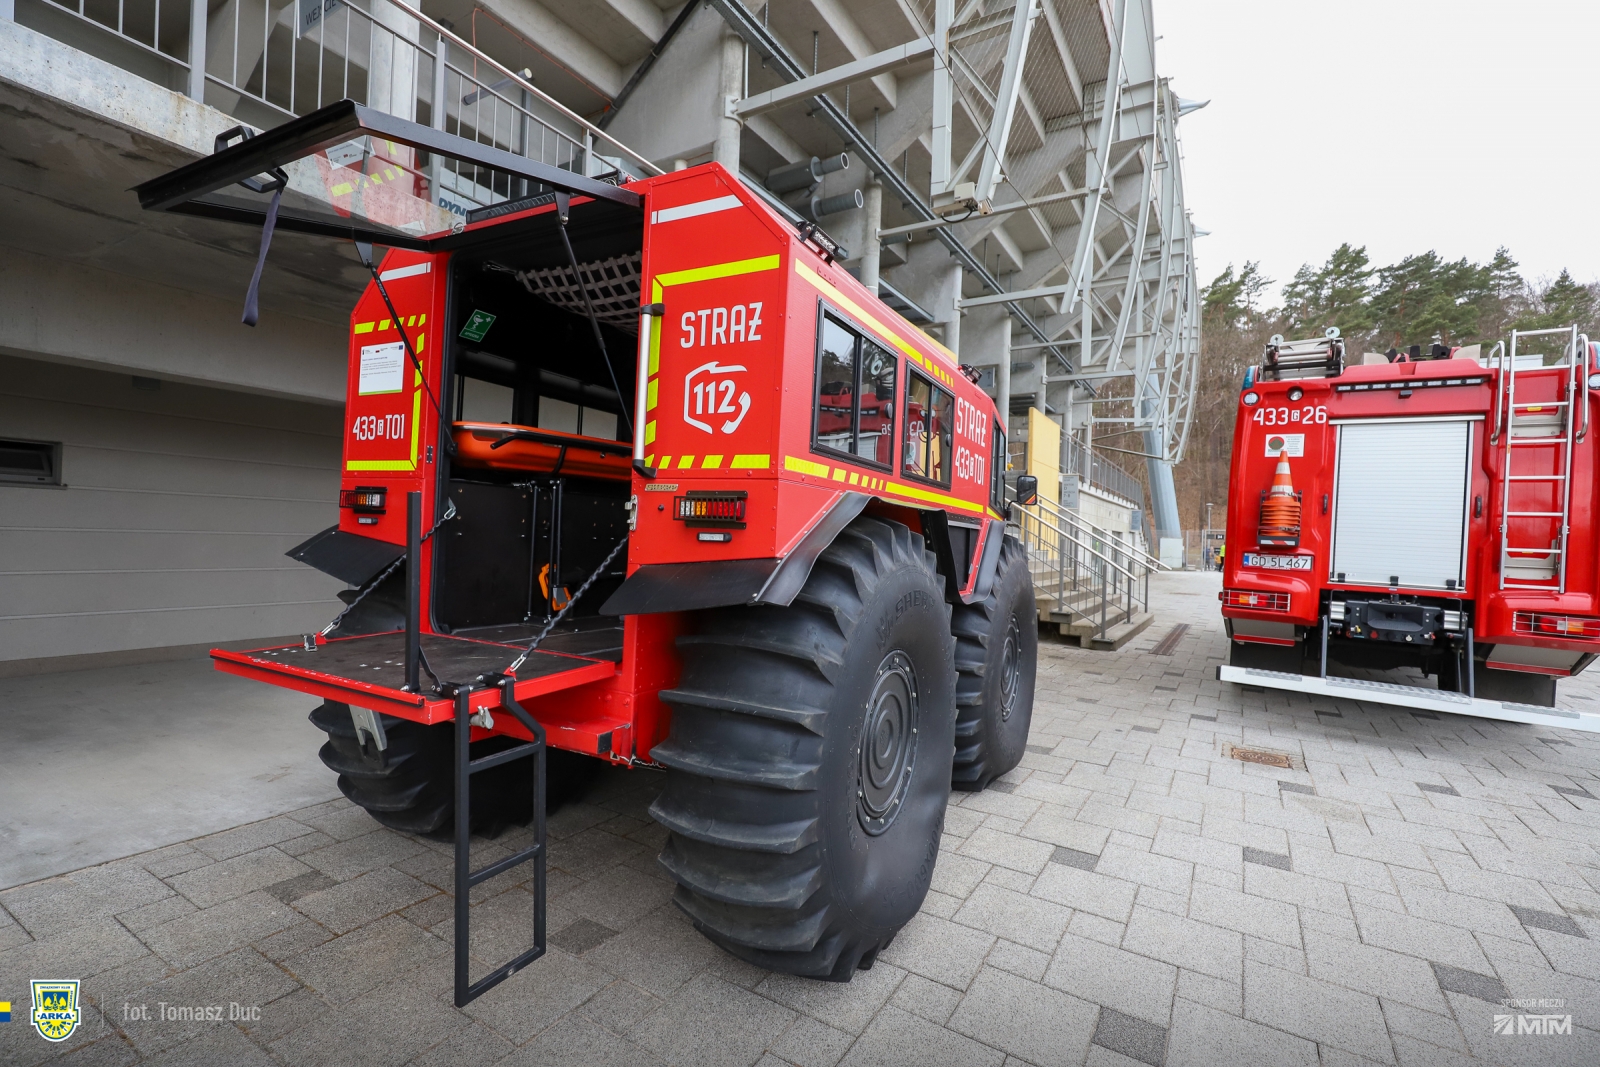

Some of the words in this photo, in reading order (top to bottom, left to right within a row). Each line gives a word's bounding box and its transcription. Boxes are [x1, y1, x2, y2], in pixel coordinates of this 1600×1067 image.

[305, 0, 336, 25] WEJCIE
[680, 301, 763, 348] STRAŻ
[693, 379, 736, 415] 112
[353, 415, 377, 440] 433
[957, 397, 986, 447] STRAŻ
[1253, 407, 1289, 426] 433
[1302, 405, 1328, 424] 26
[955, 445, 970, 480] 433
[1251, 556, 1266, 566] GD
[1270, 558, 1308, 569] 5L467
